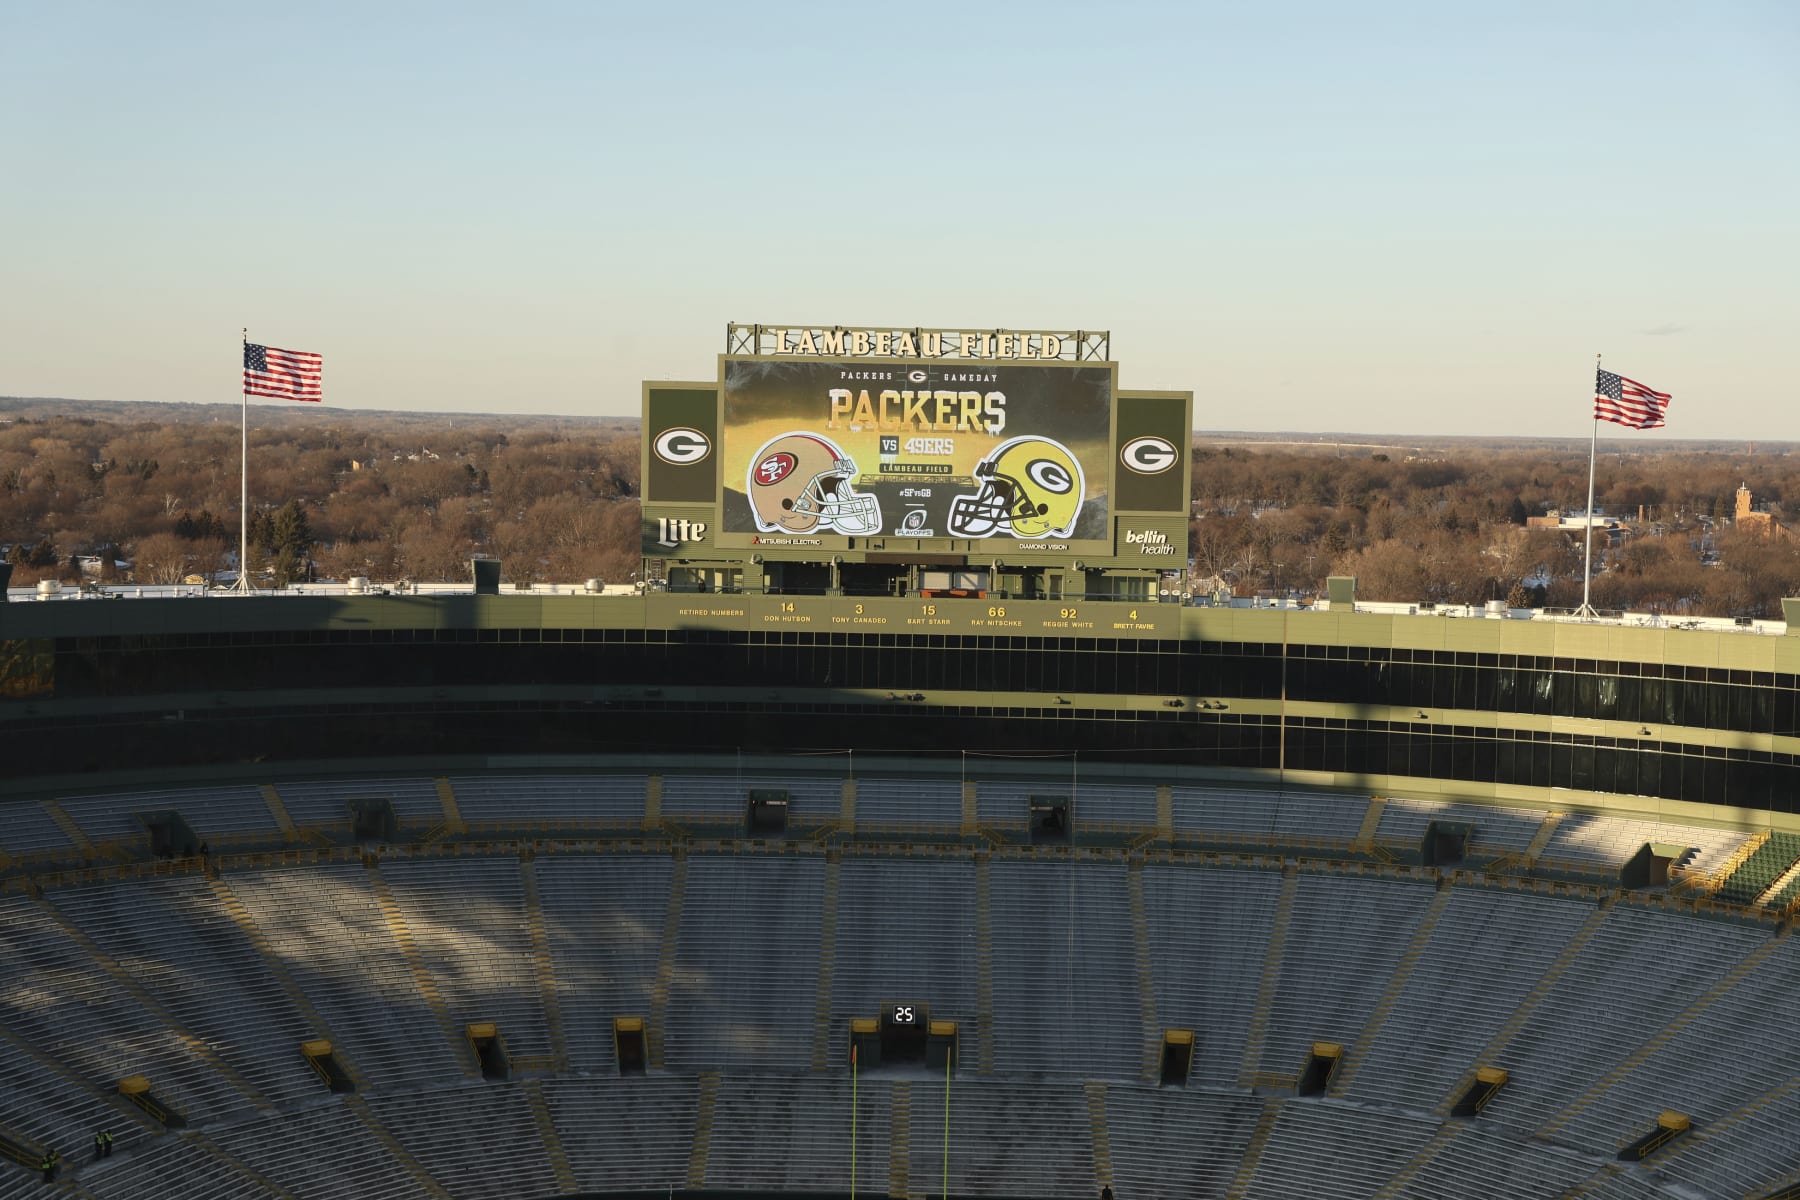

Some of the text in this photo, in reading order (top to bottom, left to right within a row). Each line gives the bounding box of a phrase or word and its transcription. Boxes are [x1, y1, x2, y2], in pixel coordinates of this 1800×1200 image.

[775, 330, 1061, 358] LAMBEAU FIELD
[840, 371, 892, 380] PACKERS
[943, 373, 998, 382] GAMEDAY
[827, 388, 1006, 434] PACKERS
[882, 438, 954, 455] VS 49ERS
[658, 517, 707, 548] Lite
[1126, 530, 1167, 544] bellin
[1141, 543, 1175, 555] health
[781, 603, 795, 613] 14
[855, 605, 864, 615] 3
[922, 606, 936, 616] 15
[988, 607, 1006, 617] 66
[1060, 609, 1077, 619] 92
[1129, 610, 1138, 620] 4
[895, 1007, 913, 1022] 25
